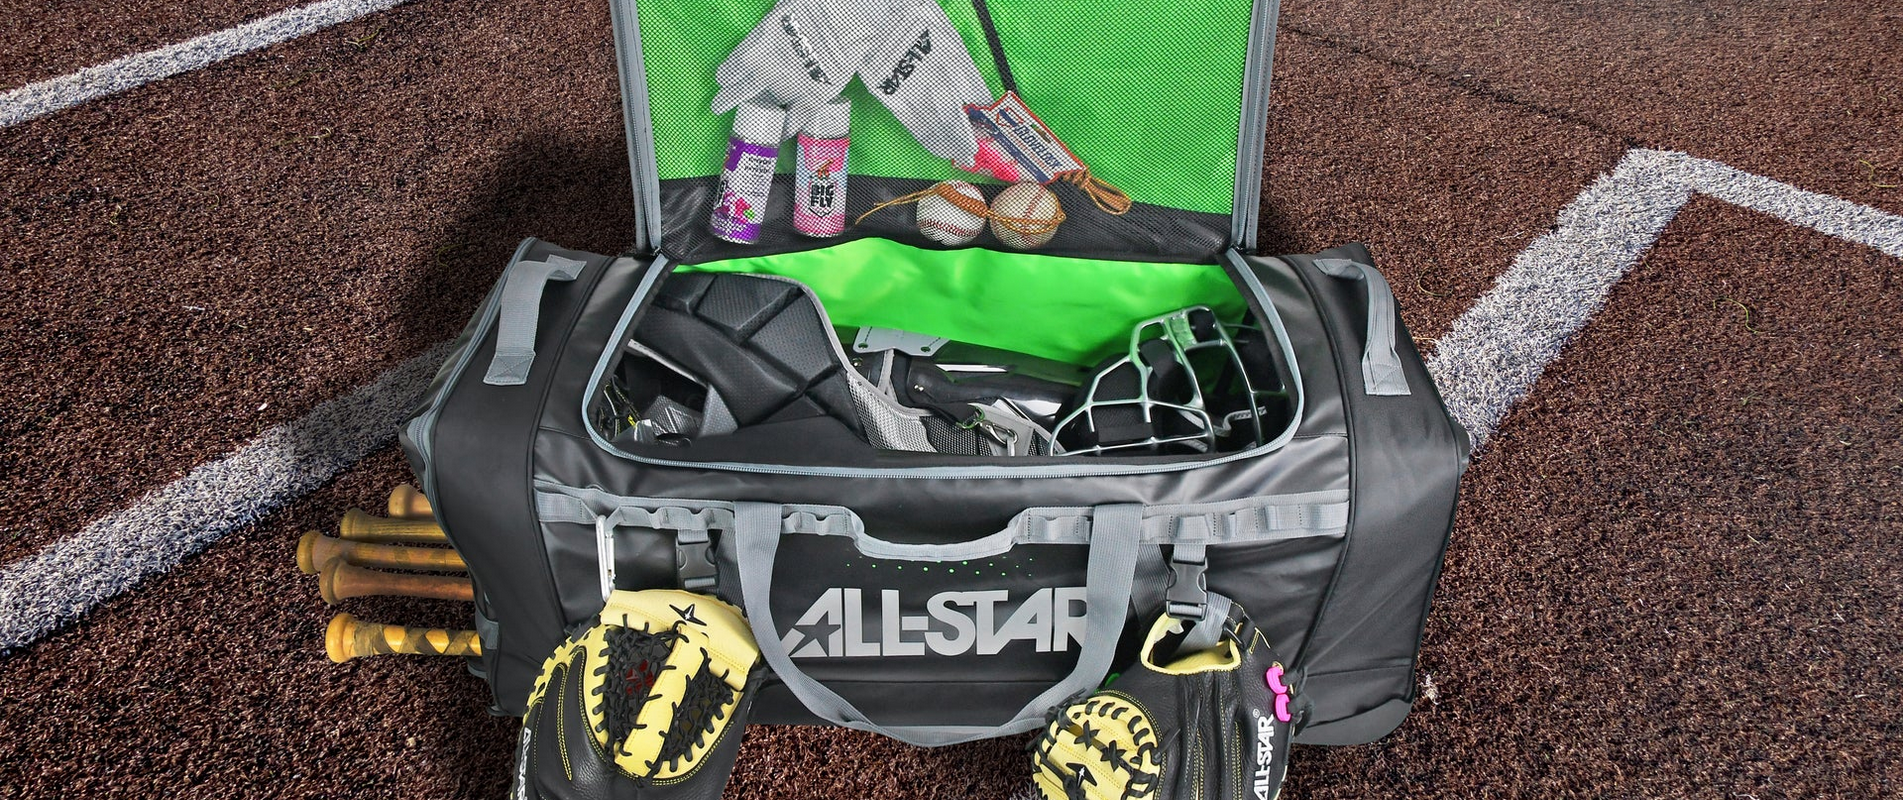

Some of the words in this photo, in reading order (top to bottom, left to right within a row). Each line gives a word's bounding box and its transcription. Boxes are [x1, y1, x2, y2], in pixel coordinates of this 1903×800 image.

[811, 182, 834, 195] BIG
[810, 195, 834, 207] FLY
[780, 587, 1088, 658] ALL-STAR
